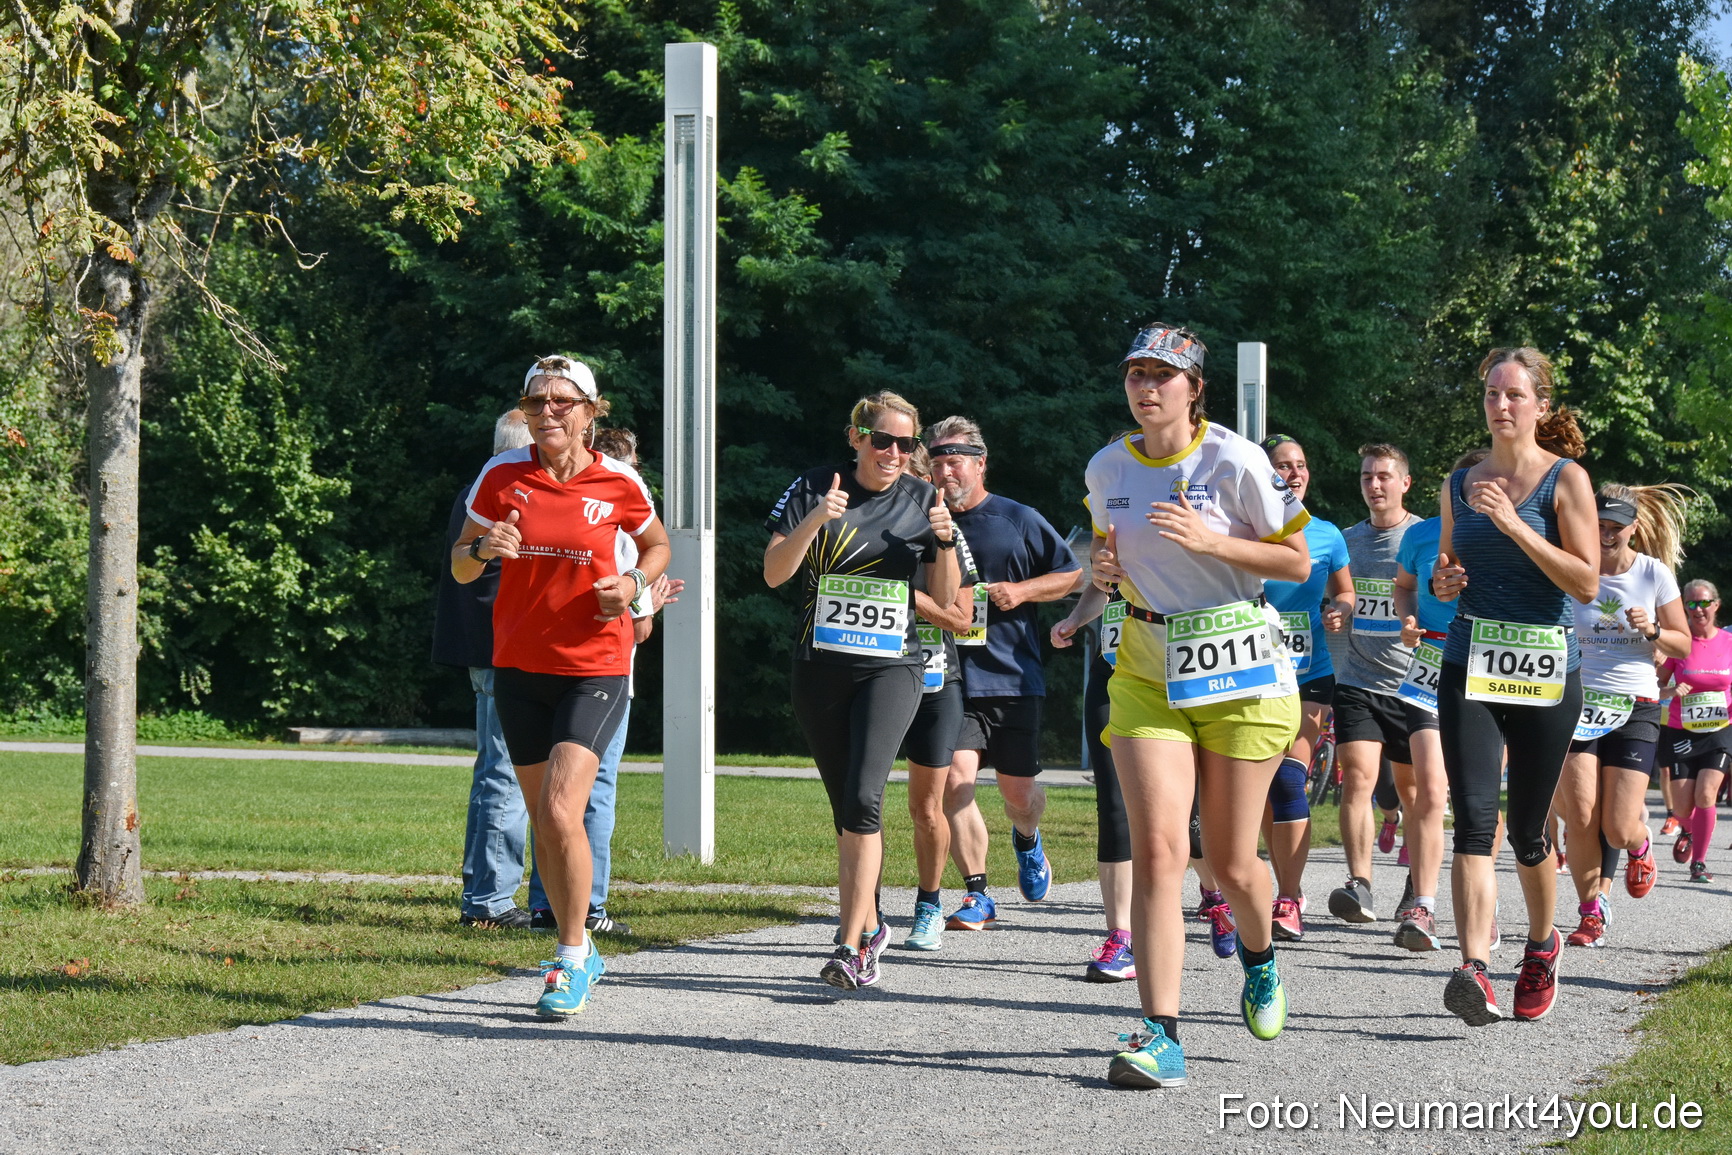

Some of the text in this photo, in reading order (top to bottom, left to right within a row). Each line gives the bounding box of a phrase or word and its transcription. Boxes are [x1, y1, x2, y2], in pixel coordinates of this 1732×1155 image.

[1107, 498, 1129, 506] BOCK
[826, 578, 901, 600] BOCK
[826, 601, 896, 630] 2595
[1173, 605, 1262, 639] BOCK
[838, 633, 878, 646] JULIA
[1480, 623, 1559, 647] BOCK
[1177, 634, 1257, 674] 2011
[1482, 650, 1555, 678] 1049
[1208, 676, 1237, 691] RIA
[1413, 666, 1438, 690] 24
[1488, 682, 1542, 695] SABINE
[1684, 695, 1724, 705] BOCK
[1580, 708, 1622, 726] 347
[1688, 706, 1722, 719] 1274
